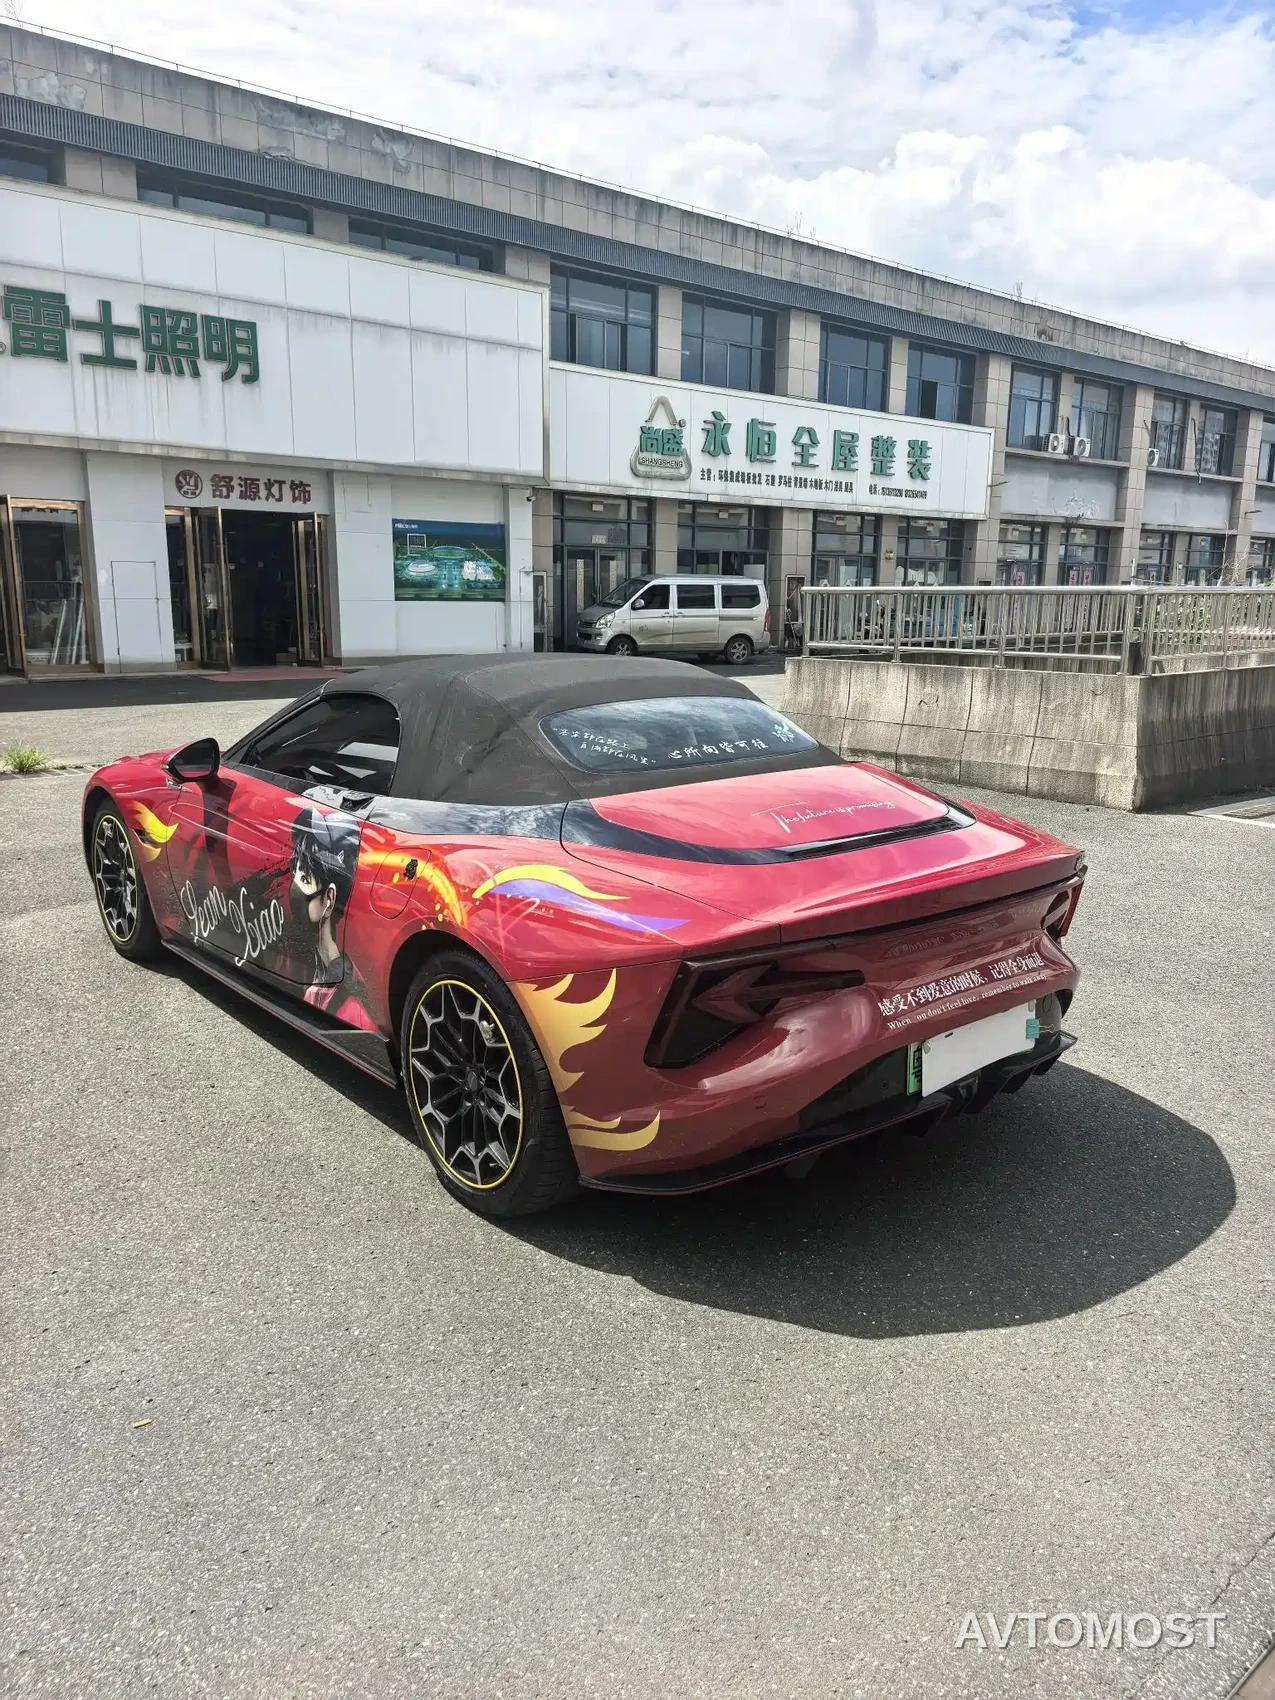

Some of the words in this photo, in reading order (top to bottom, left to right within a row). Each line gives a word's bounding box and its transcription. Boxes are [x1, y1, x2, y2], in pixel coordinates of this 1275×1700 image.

[3, 285, 260, 384] 雷士照明
[640, 425, 684, 457] 尚盛
[701, 410, 933, 481] 永恒全屋整装
[641, 456, 684, 468] SHANGSHENG
[210, 473, 312, 504] 舒源灯饰
[887, 1017, 912, 1030] When
[914, 1012, 927, 1021] ou
[927, 1004, 945, 1017] don't
[944, 999, 961, 1011] feel
[981, 984, 1012, 999] remember
[1011, 981, 1020, 989] to
